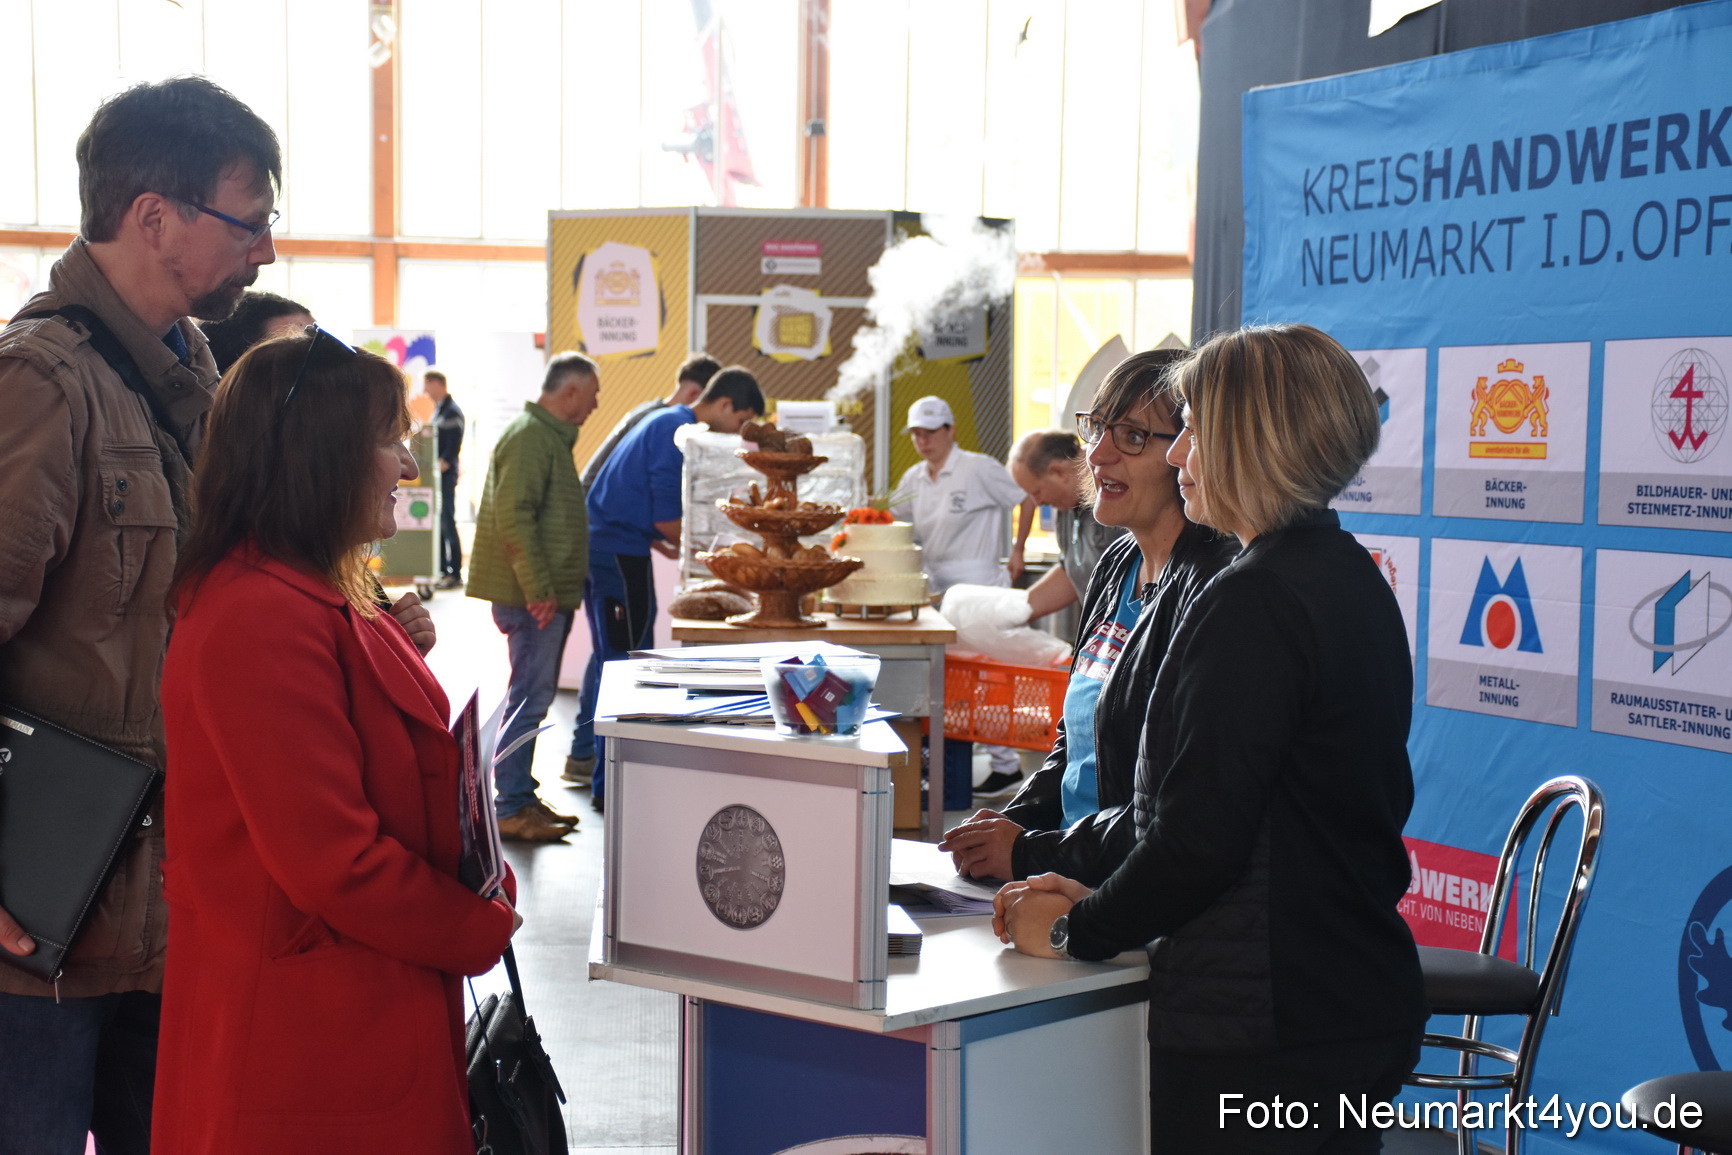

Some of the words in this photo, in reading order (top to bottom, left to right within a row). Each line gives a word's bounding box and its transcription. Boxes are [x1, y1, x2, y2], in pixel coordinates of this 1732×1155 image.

[1301, 216, 1526, 288] NEUMARKT
[1540, 194, 1732, 270] I.D.OPF
[1485, 477, 1527, 493] BÄCKER-
[1636, 484, 1708, 499] BILDHAUER-
[1485, 496, 1526, 509] INNUNG
[1479, 674, 1520, 690] METALL-
[1479, 690, 1519, 707] INNUNG
[1610, 692, 1722, 720] RAUMAUSSTATTER-
[1627, 712, 1731, 740] SATTLER-INNUNG
[1420, 903, 1443, 924] VON
